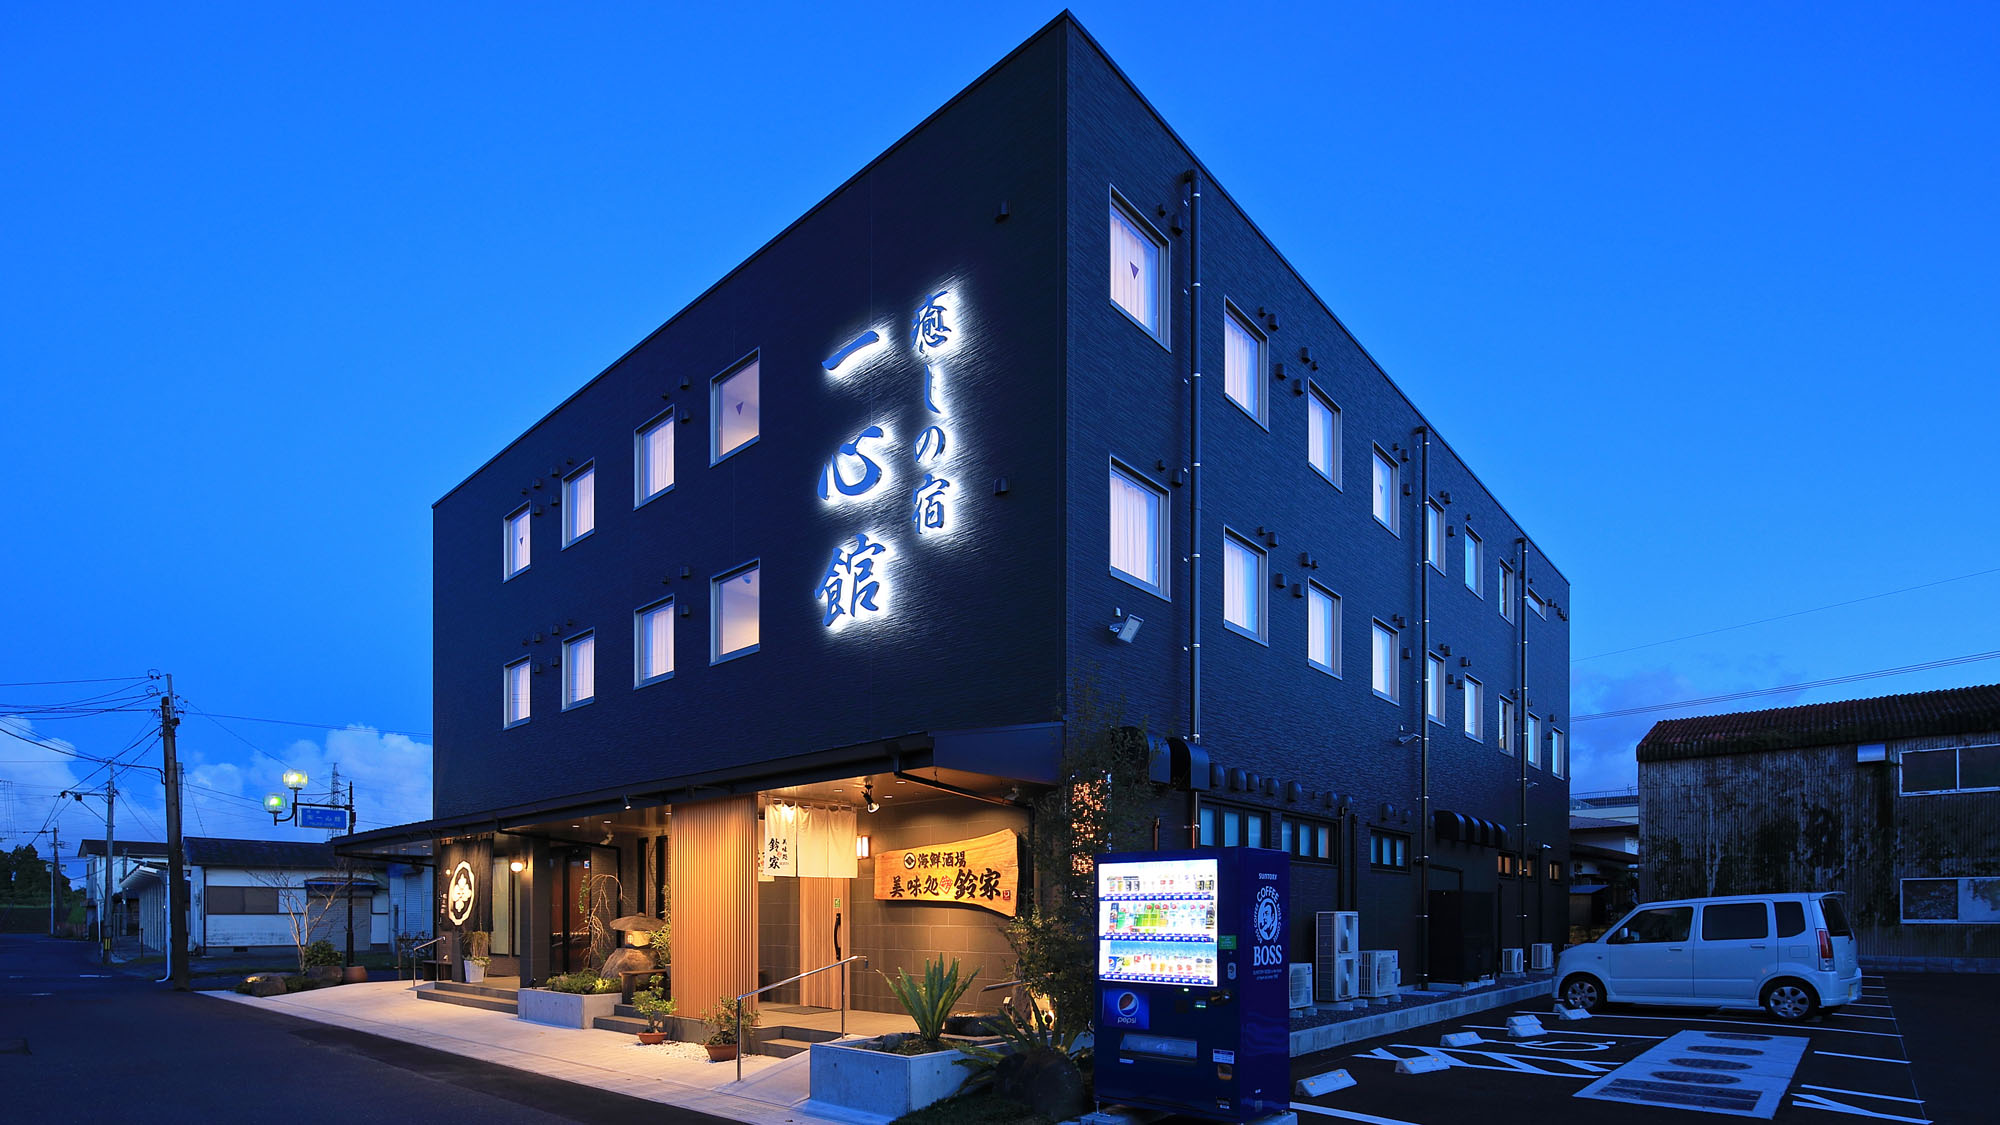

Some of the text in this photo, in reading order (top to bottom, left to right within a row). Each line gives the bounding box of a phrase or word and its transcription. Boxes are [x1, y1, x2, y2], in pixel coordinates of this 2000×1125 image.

[911, 290, 951, 535] 癒しの宿
[814, 330, 884, 627] 一心館
[768, 838, 780, 869] 鈴家
[917, 851, 967, 868] 海鮮酒場
[890, 875, 939, 898] 美味処
[954, 868, 1001, 900] 鈴家
[1257, 886, 1279, 903] COFFEE
[1253, 944, 1282, 966] BOSS
